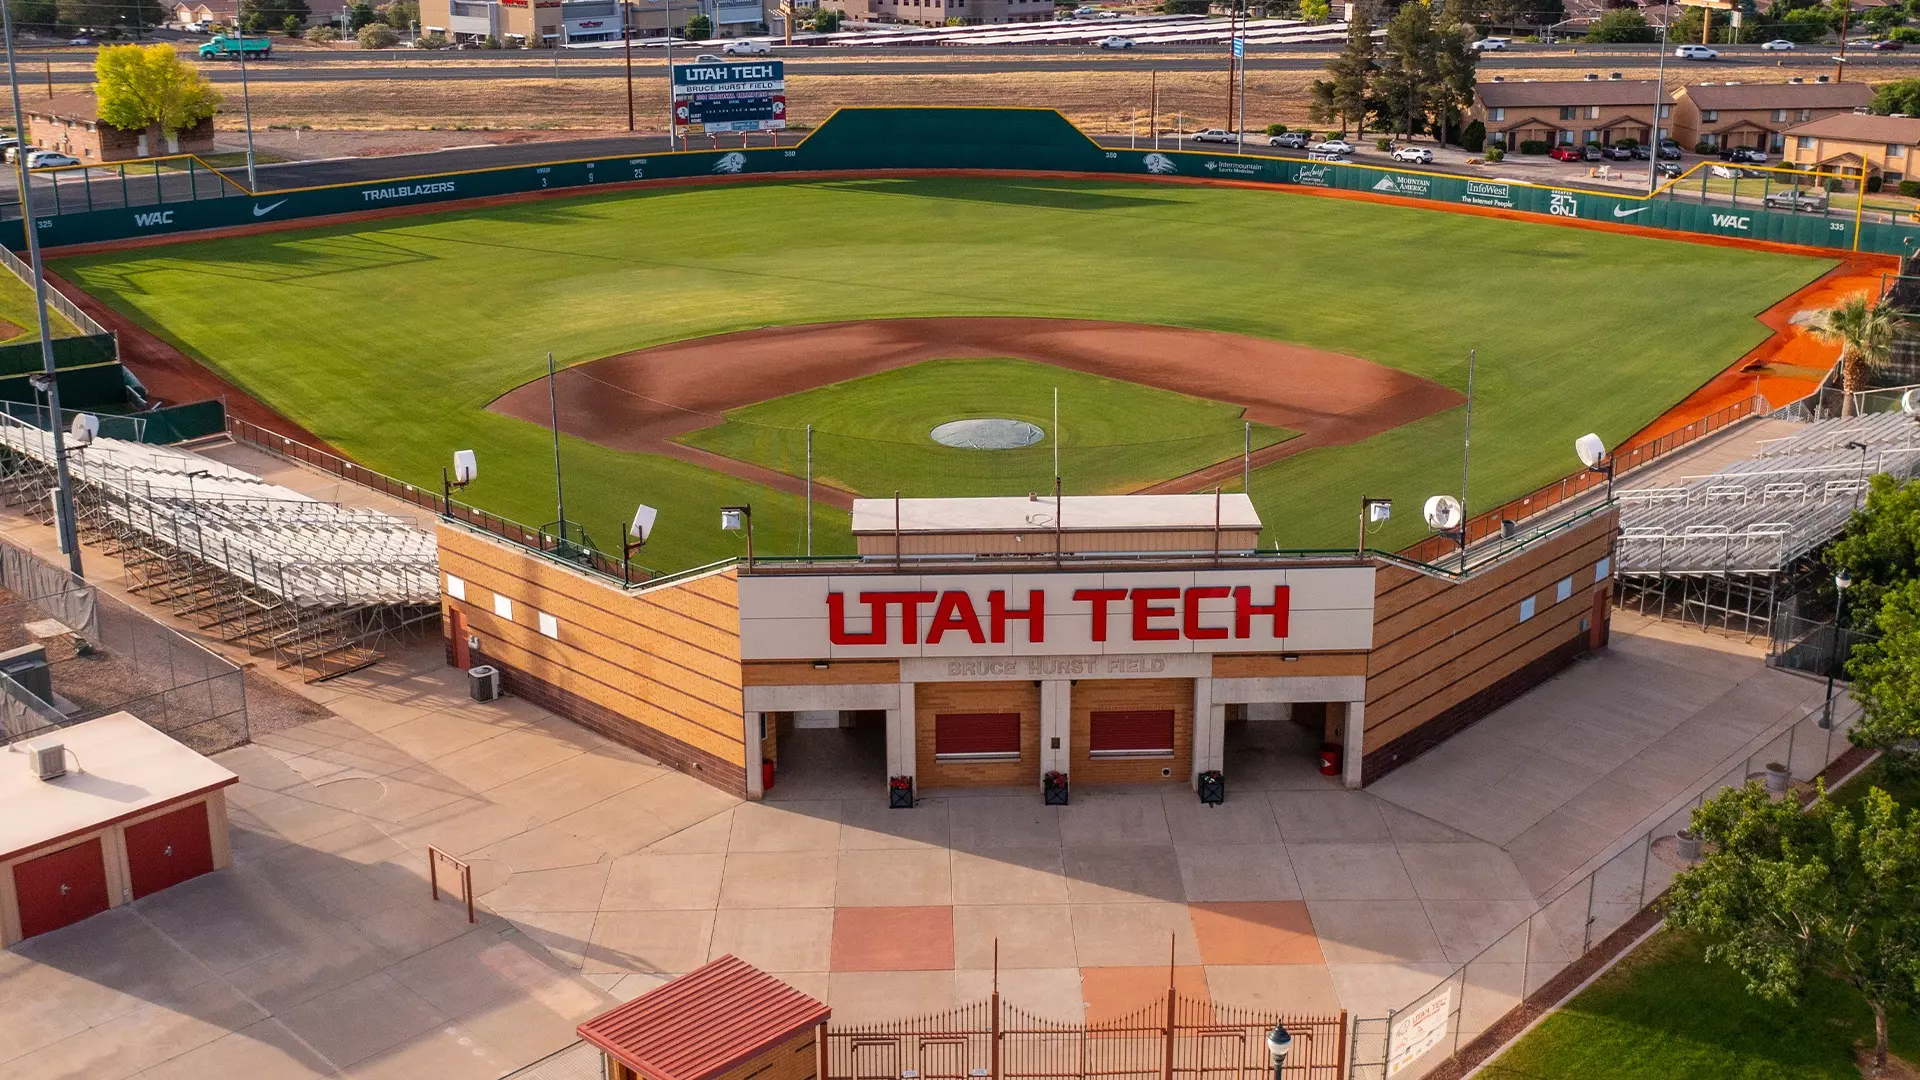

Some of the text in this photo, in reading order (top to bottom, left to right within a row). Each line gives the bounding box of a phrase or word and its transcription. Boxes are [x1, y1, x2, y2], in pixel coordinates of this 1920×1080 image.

[686, 65, 773, 81] UTAH TECH
[686, 82, 773, 93] BRUCE HURST FIELD
[1218, 161, 1262, 170] Intermountain
[588, 172, 594, 182] 9
[634, 168, 643, 178] 25
[542, 177, 547, 187] 3
[1397, 176, 1430, 186] MOUNTAIN
[362, 181, 455, 201] TRAILBLAZERS
[1400, 184, 1427, 192] AMERICA
[1470, 183, 1506, 196] InfoWest
[1462, 195, 1513, 208] The Internet People
[134, 210, 174, 227] WAC
[1712, 213, 1750, 230] WAC
[37, 220, 53, 229] 325
[1829, 222, 1845, 231] 335
[826, 585, 1290, 645] UTAH TECH
[947, 657, 1166, 676] BRUCE HURST FIELD
